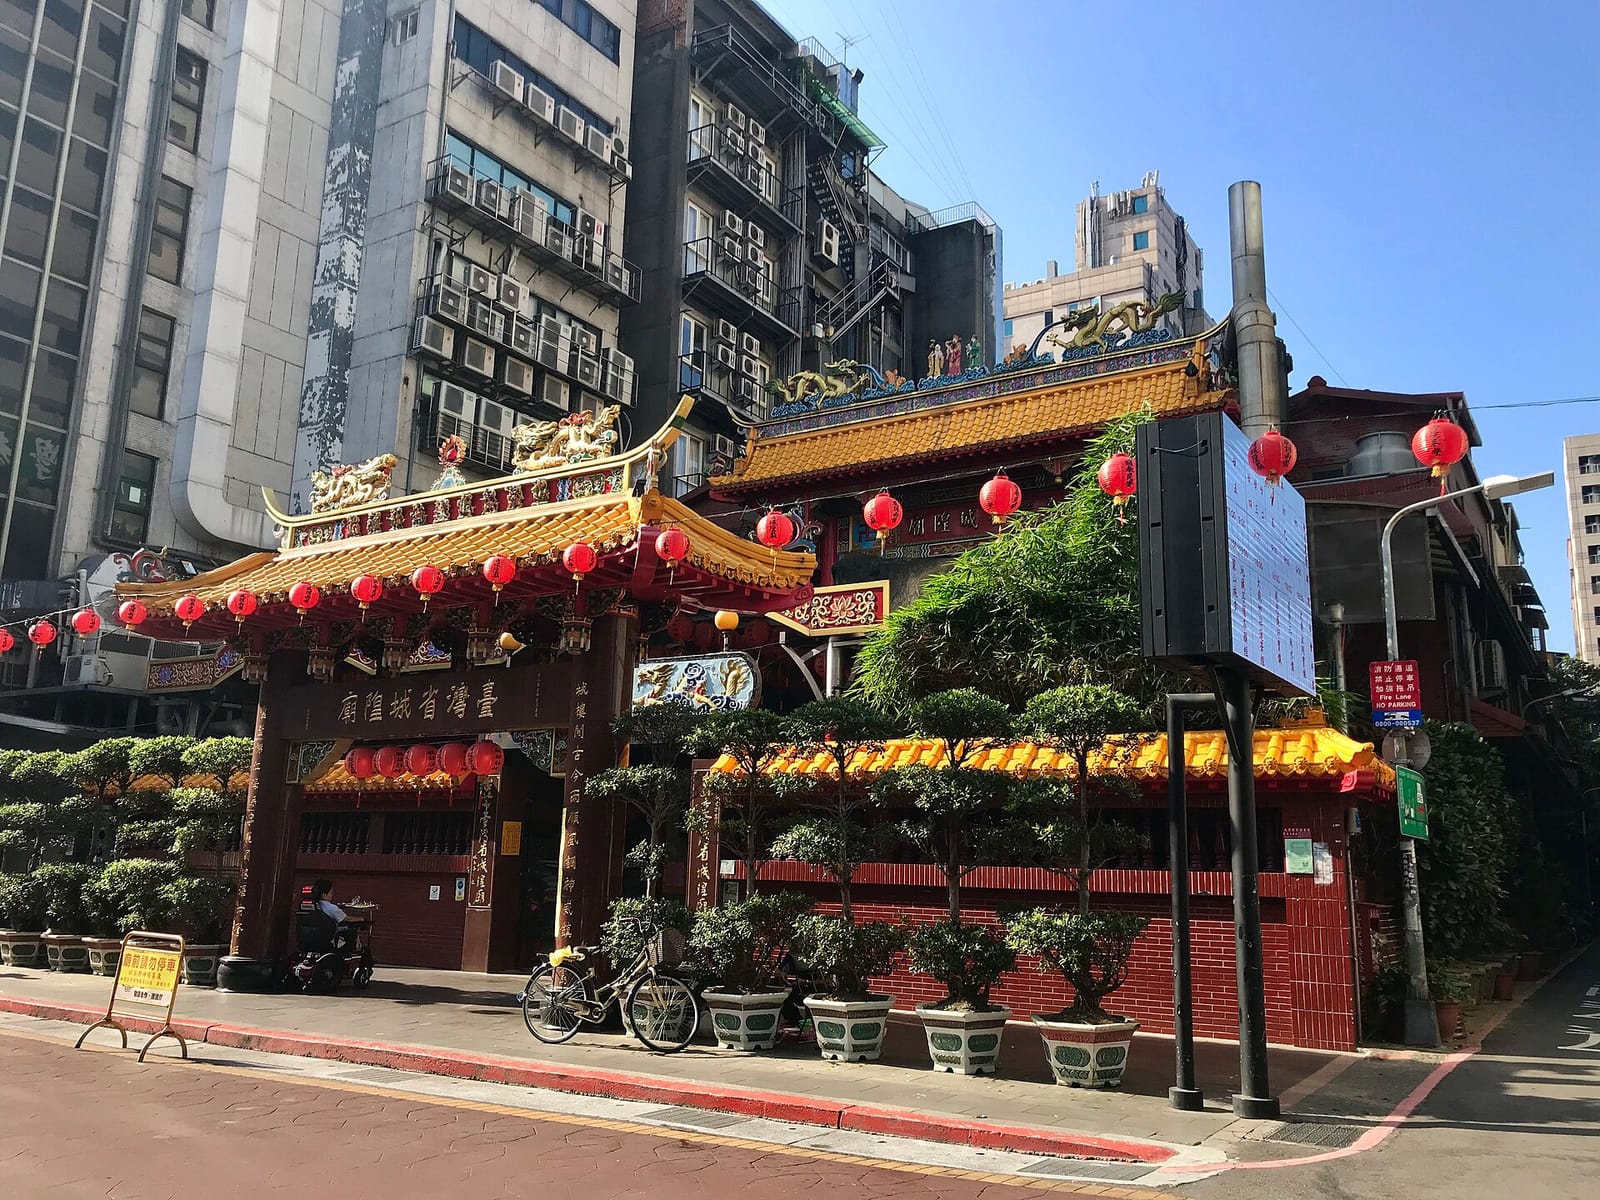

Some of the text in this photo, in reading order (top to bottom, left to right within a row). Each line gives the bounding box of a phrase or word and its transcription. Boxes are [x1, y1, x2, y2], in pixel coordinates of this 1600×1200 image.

[1374, 664, 1413, 673] 消防通道
[1374, 674, 1414, 683] 禁止停車
[1375, 683, 1415, 693] 加強拖吊
[337, 677, 499, 725] 臺灣省城隍廟
[123, 953, 176, 973] 廟前請勿停車
